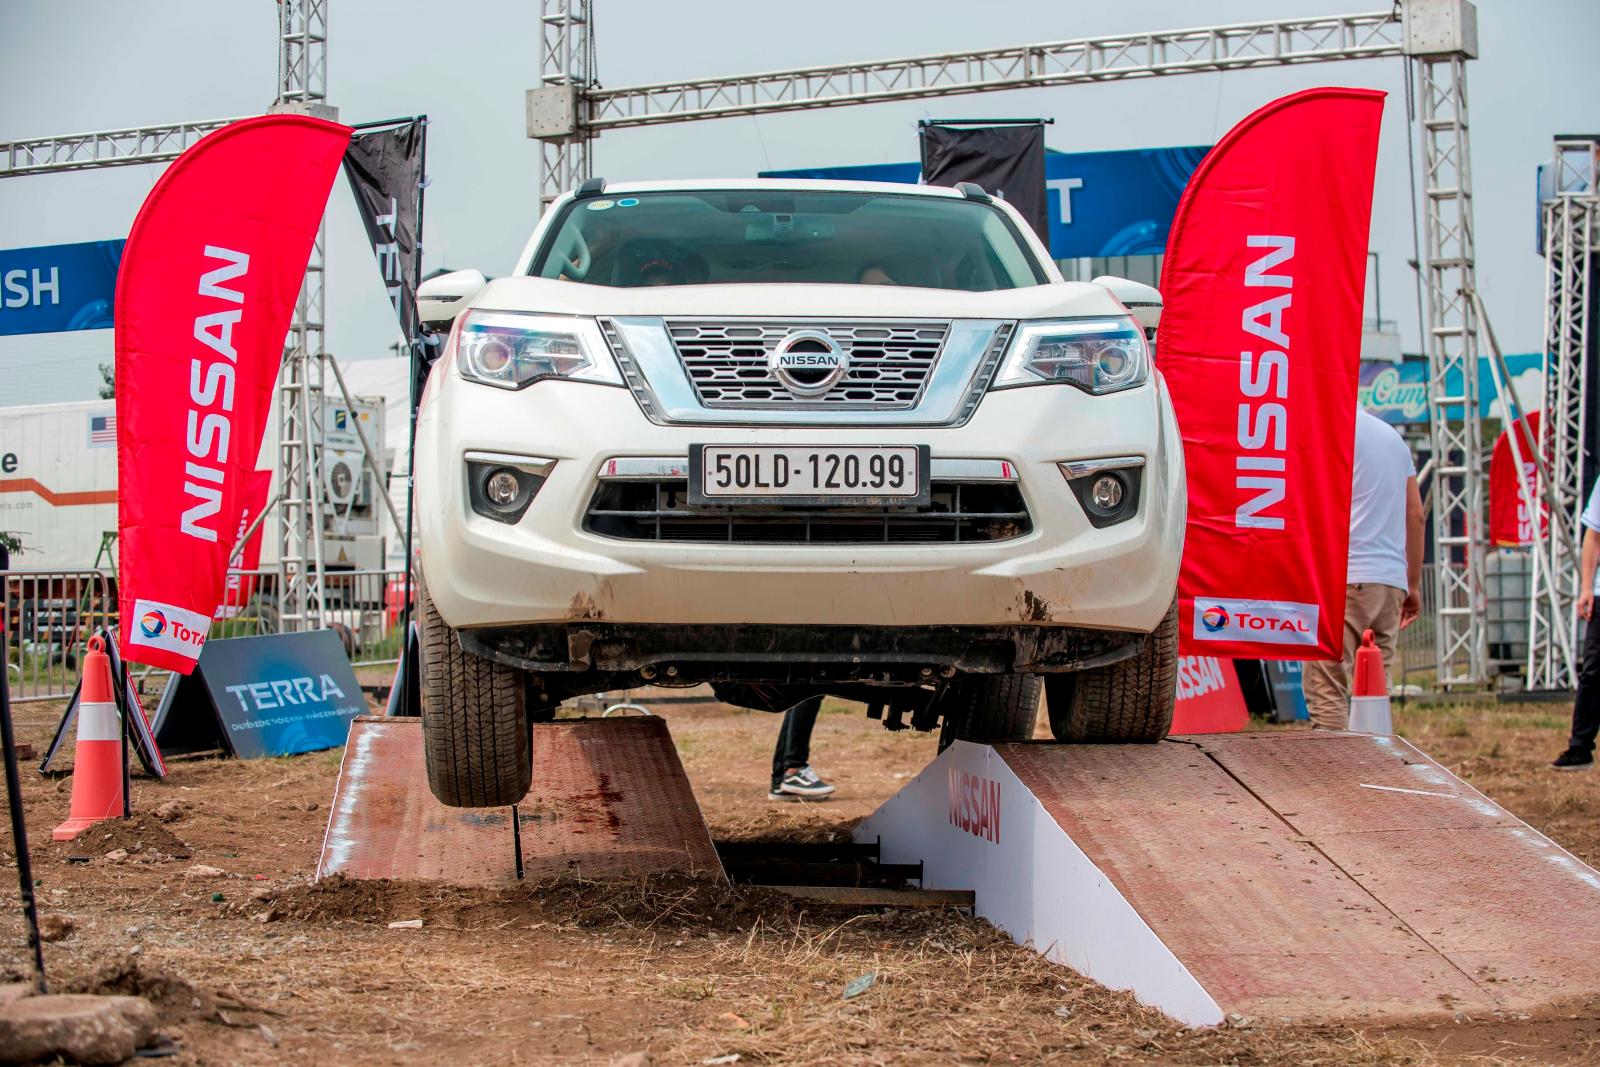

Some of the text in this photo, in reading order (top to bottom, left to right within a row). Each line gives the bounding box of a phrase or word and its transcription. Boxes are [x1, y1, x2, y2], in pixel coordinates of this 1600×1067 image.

[0, 266, 60, 309] SH
[780, 355, 839, 366] NISSAN
[180, 244, 250, 543] NISSAN
[1235, 235, 1295, 530] NISSAN
[716, 453, 905, 489] 50LD-120.99
[1234, 613, 1310, 632] TOTAL
[225, 674, 346, 712] TERRA
[948, 767, 1001, 845] NISSAN
